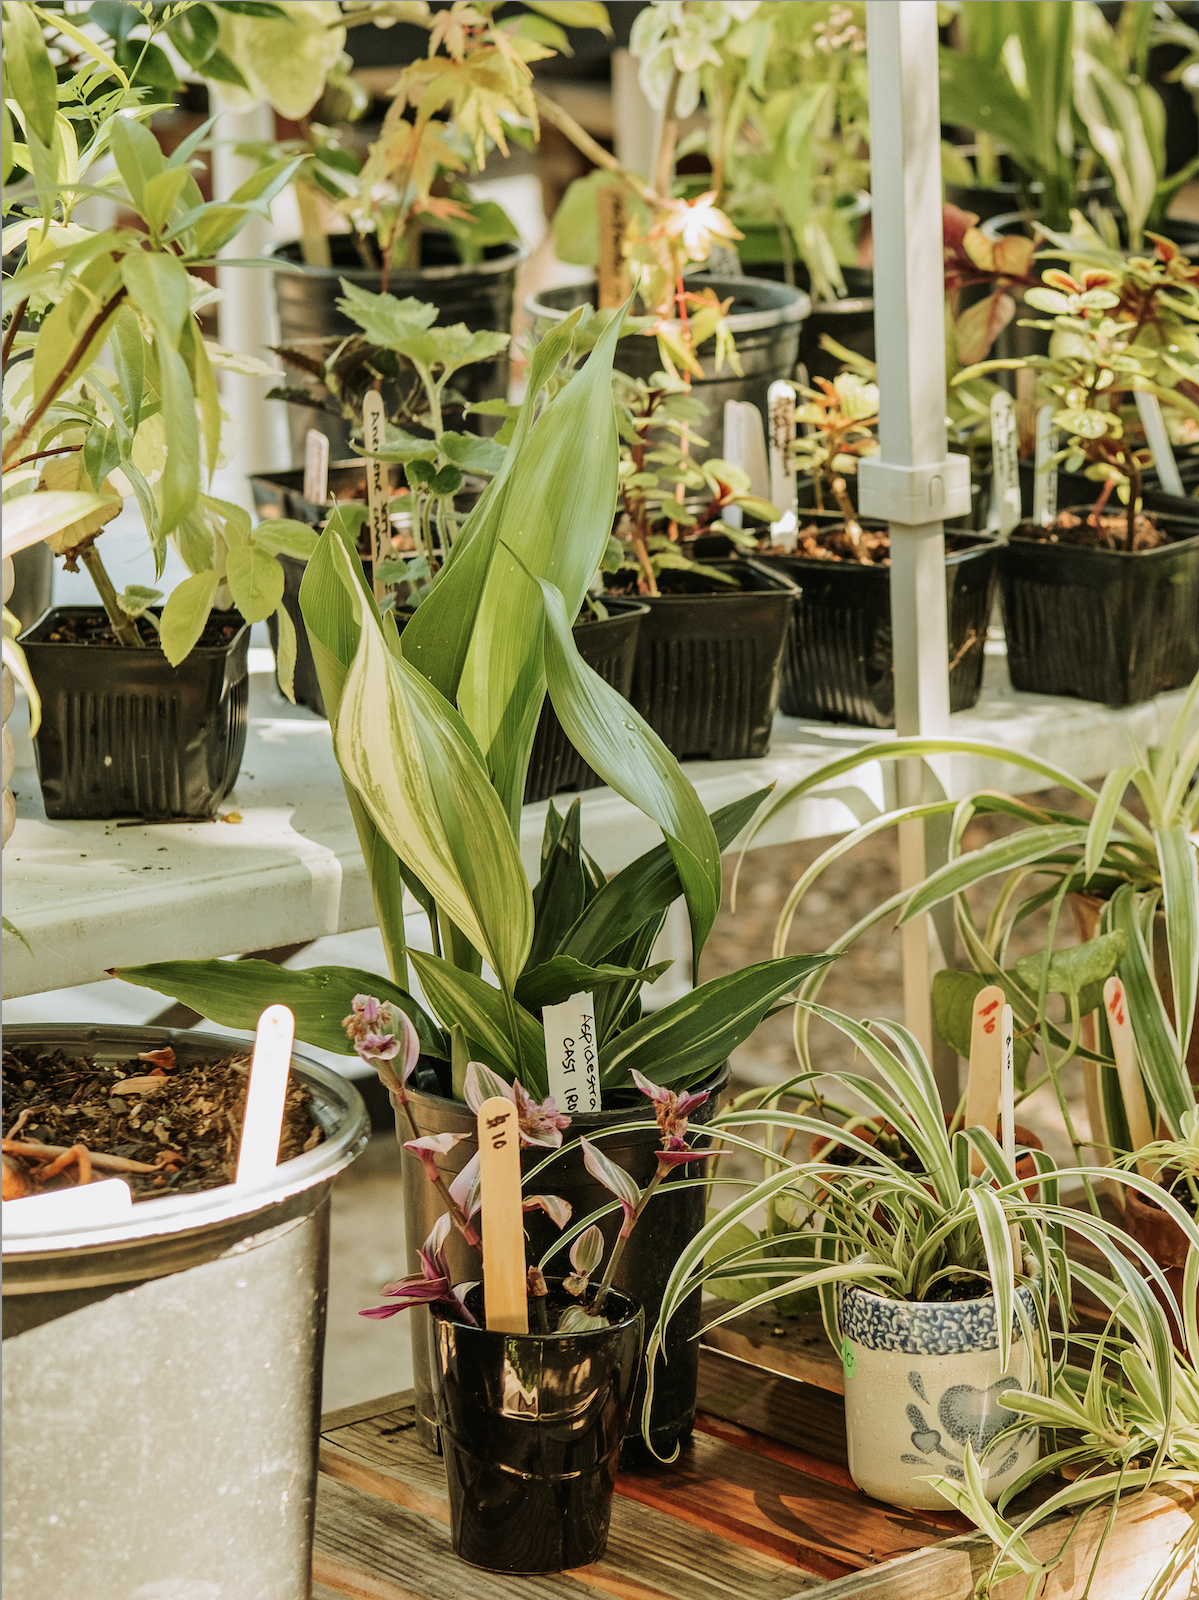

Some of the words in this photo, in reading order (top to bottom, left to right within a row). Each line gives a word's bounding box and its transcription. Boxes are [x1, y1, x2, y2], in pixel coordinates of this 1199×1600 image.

[561, 1037, 577, 1075] CAST
[563, 1087, 579, 1113] IRO
[485, 1112, 511, 1150] $10
